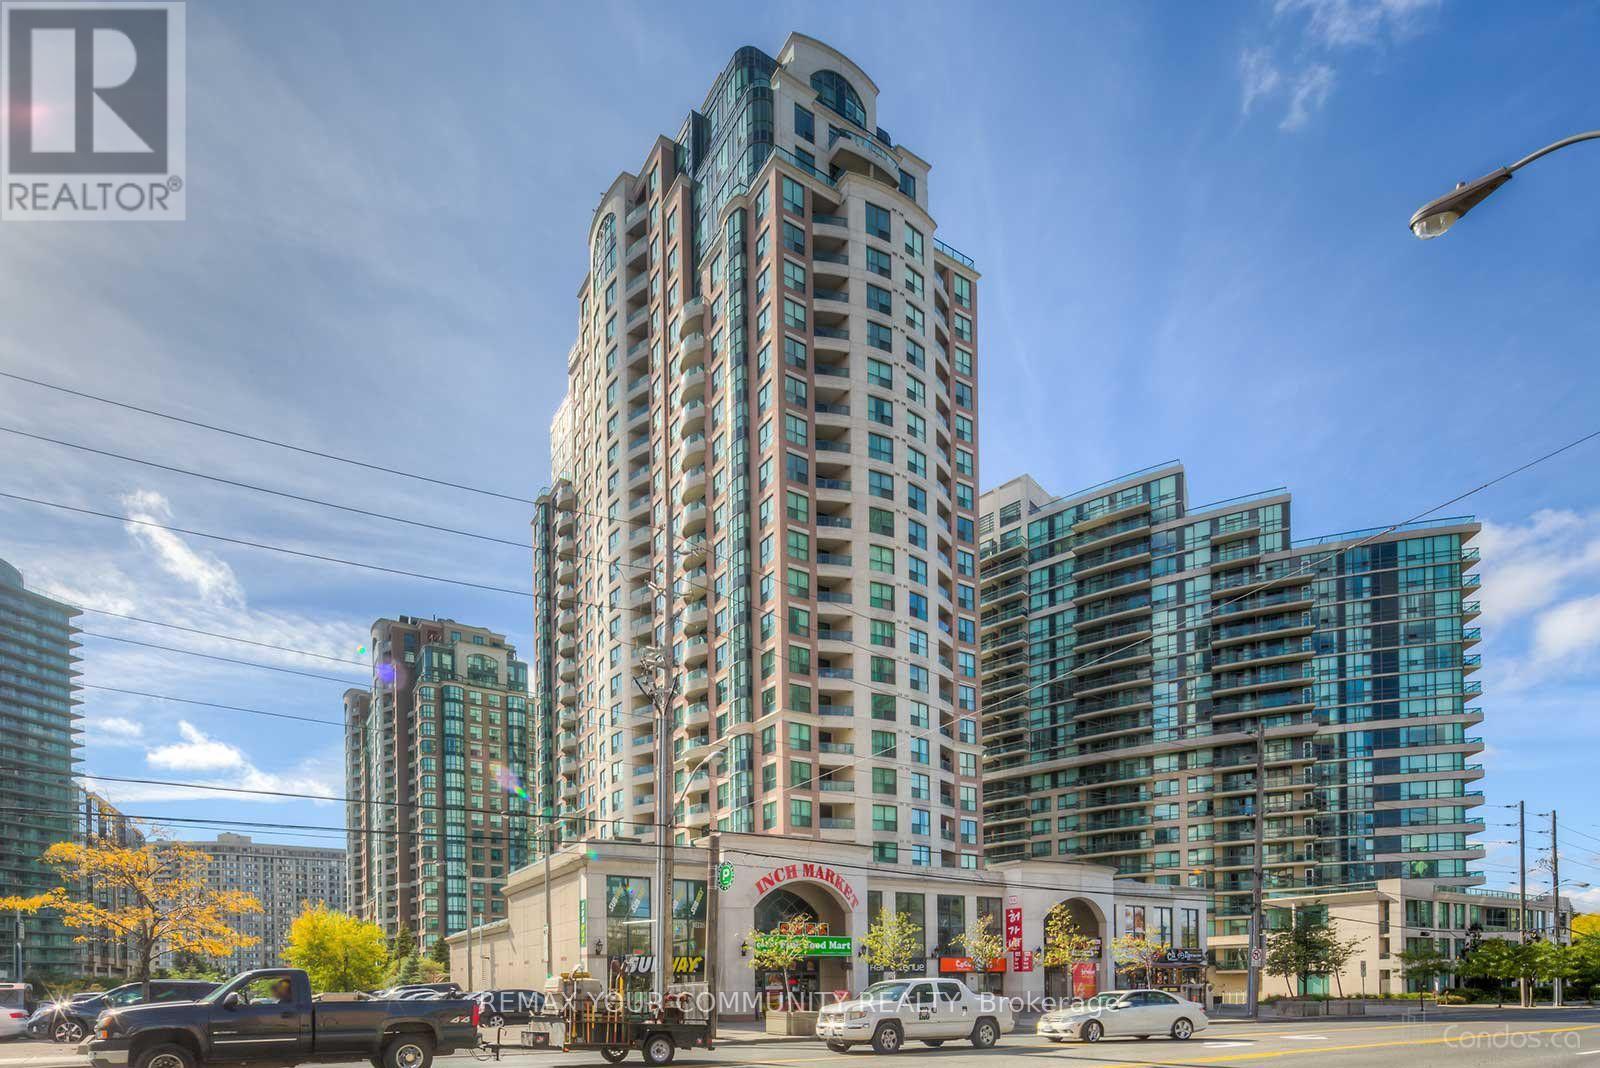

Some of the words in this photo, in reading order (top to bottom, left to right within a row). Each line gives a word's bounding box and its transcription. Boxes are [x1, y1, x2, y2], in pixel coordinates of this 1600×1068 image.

[755, 864, 798, 895] INCH
[802, 863, 859, 910] MARKET
[828, 940, 851, 950] Mart
